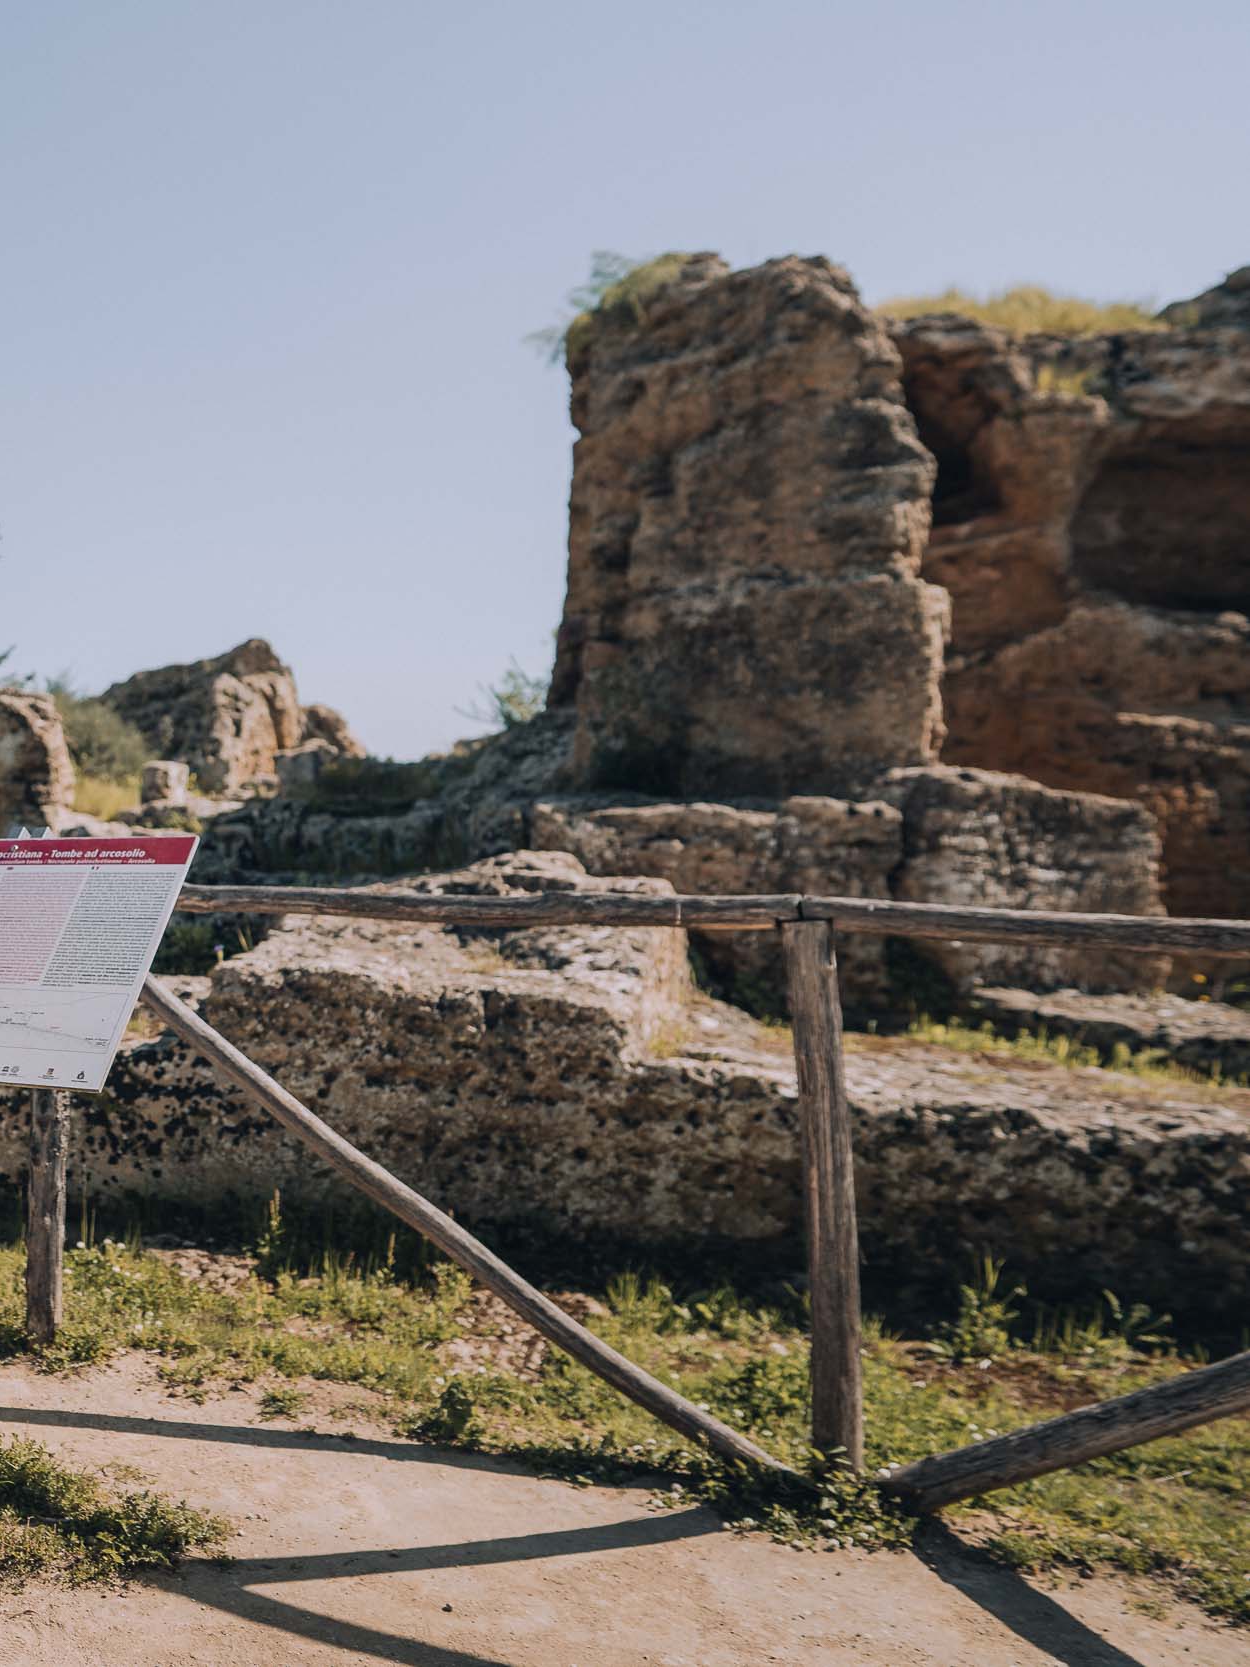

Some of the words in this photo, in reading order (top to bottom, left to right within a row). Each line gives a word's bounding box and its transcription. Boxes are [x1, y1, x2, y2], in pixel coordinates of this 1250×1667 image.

[51, 850, 83, 858] Tombe
[84, 848, 99, 858] ad
[99, 848, 146, 858] arcosolio
